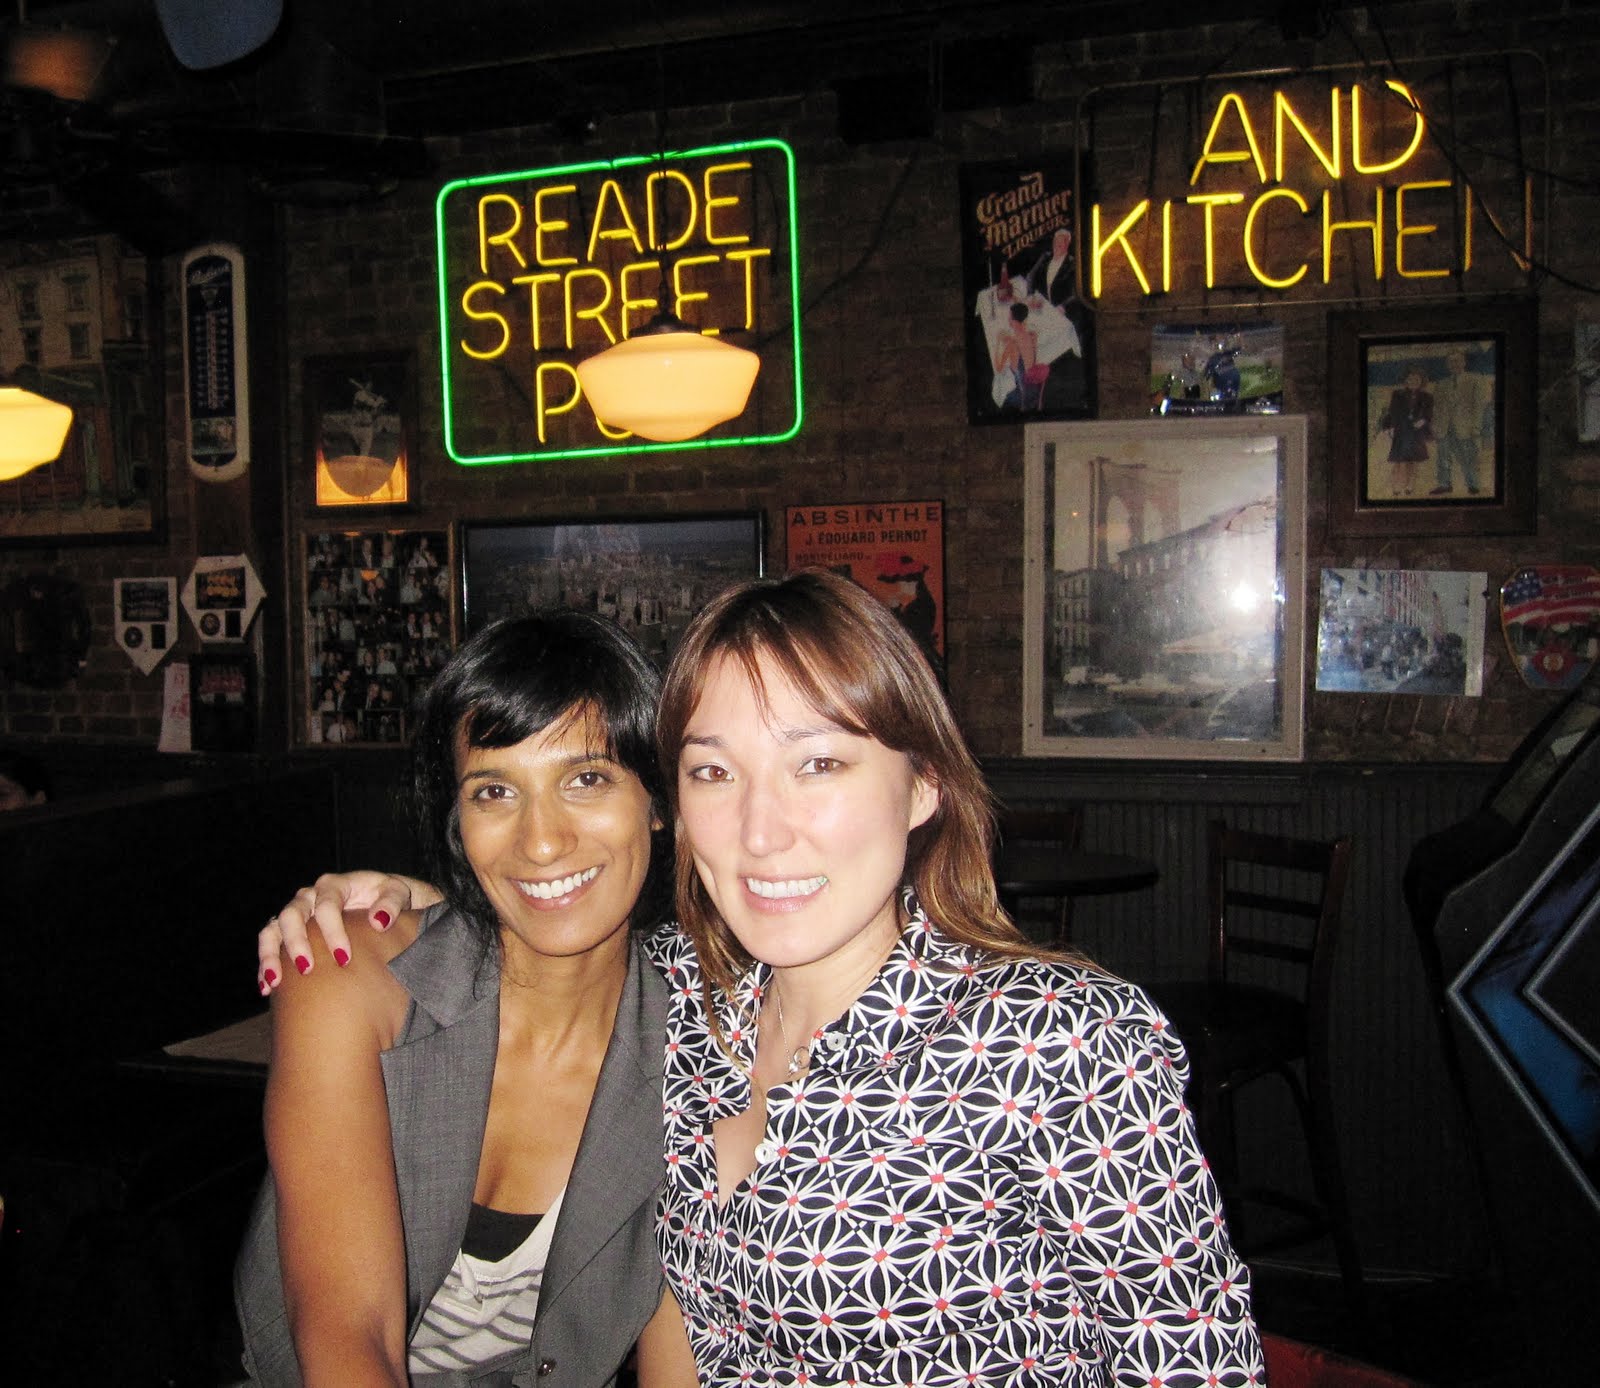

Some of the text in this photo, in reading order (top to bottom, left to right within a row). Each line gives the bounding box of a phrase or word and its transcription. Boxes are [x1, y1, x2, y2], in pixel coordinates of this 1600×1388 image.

[1191, 80, 1424, 186] AND
[479, 162, 752, 273] READE
[977, 172, 1043, 223] Grand
[1092, 177, 1532, 298] KITCHEN
[462, 249, 771, 359] STREET
[792, 507, 939, 525] ABSINTHE
[881, 530, 927, 543] PERNOT
